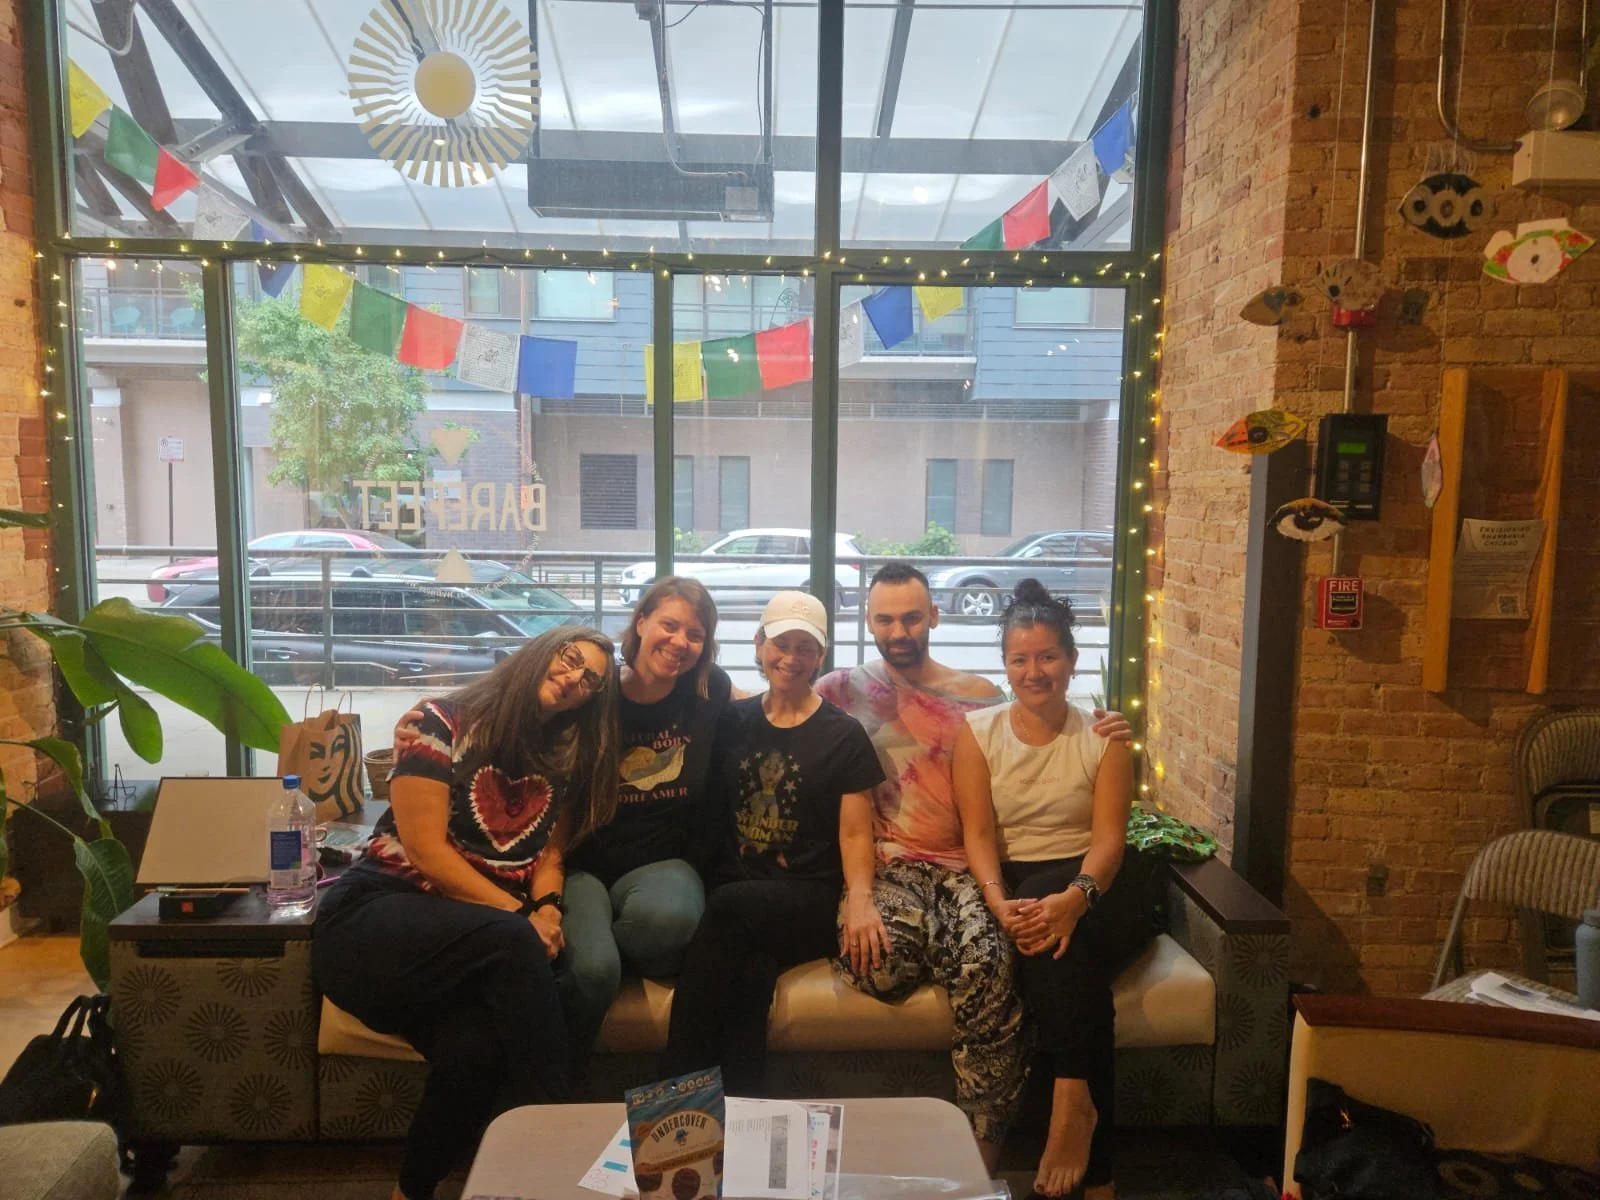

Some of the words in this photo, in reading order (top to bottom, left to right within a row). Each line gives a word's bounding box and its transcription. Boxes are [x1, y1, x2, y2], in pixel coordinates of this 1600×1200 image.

[1329, 580, 1360, 592] FIRE
[652, 735, 692, 750] BORN
[650, 1113, 709, 1143] UNDERCOVER
